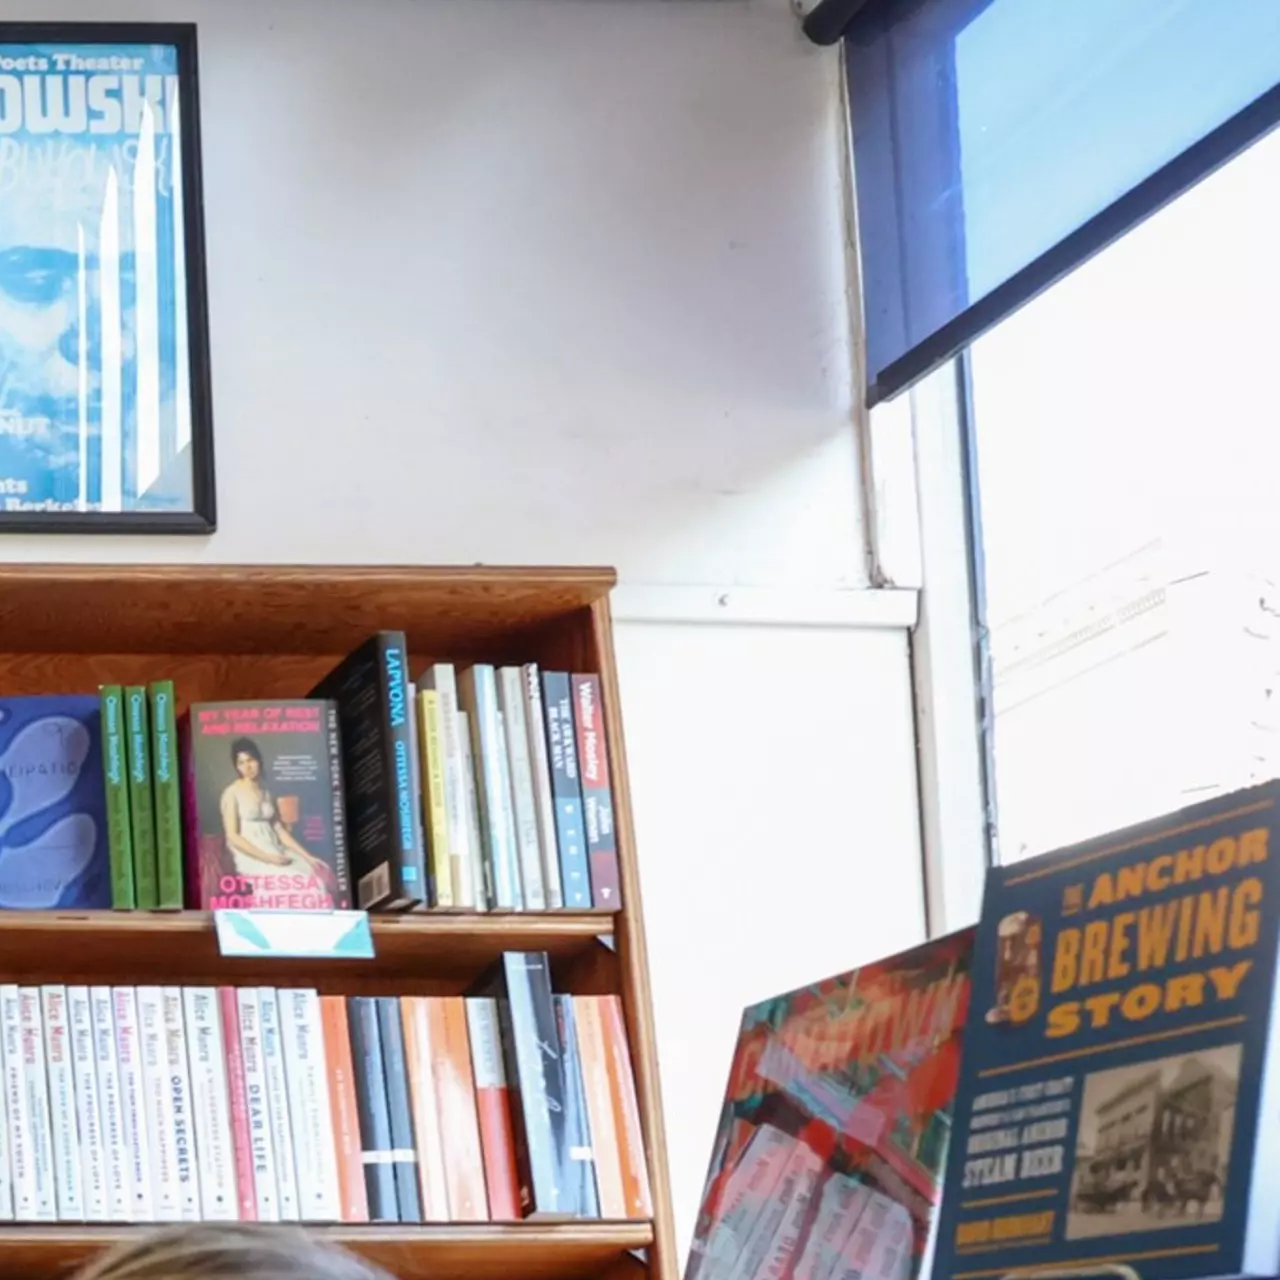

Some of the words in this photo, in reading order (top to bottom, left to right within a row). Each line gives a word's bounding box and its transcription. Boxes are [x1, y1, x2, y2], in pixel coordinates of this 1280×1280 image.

[53, 54, 144, 71] Theater
[385, 648, 404, 727] LAPVONA
[227, 709, 260, 720] YEAR
[263, 708, 281, 719] OF
[285, 707, 320, 718] REST
[233, 722, 320, 733] RELAXATION
[220, 875, 318, 893] OTTESSA
[1089, 827, 1269, 908] ANCHOR
[209, 894, 333, 910] MOSHFEGH
[1051, 877, 1264, 995] BREWING
[1046, 961, 1253, 1038] STORY
[171, 1075, 183, 1114] OPEN
[249, 1084, 264, 1130] DEAR
[174, 1117, 190, 1184] SECRETS
[253, 1136, 267, 1173] LIFE
[962, 1152, 1017, 1189] STEAM
